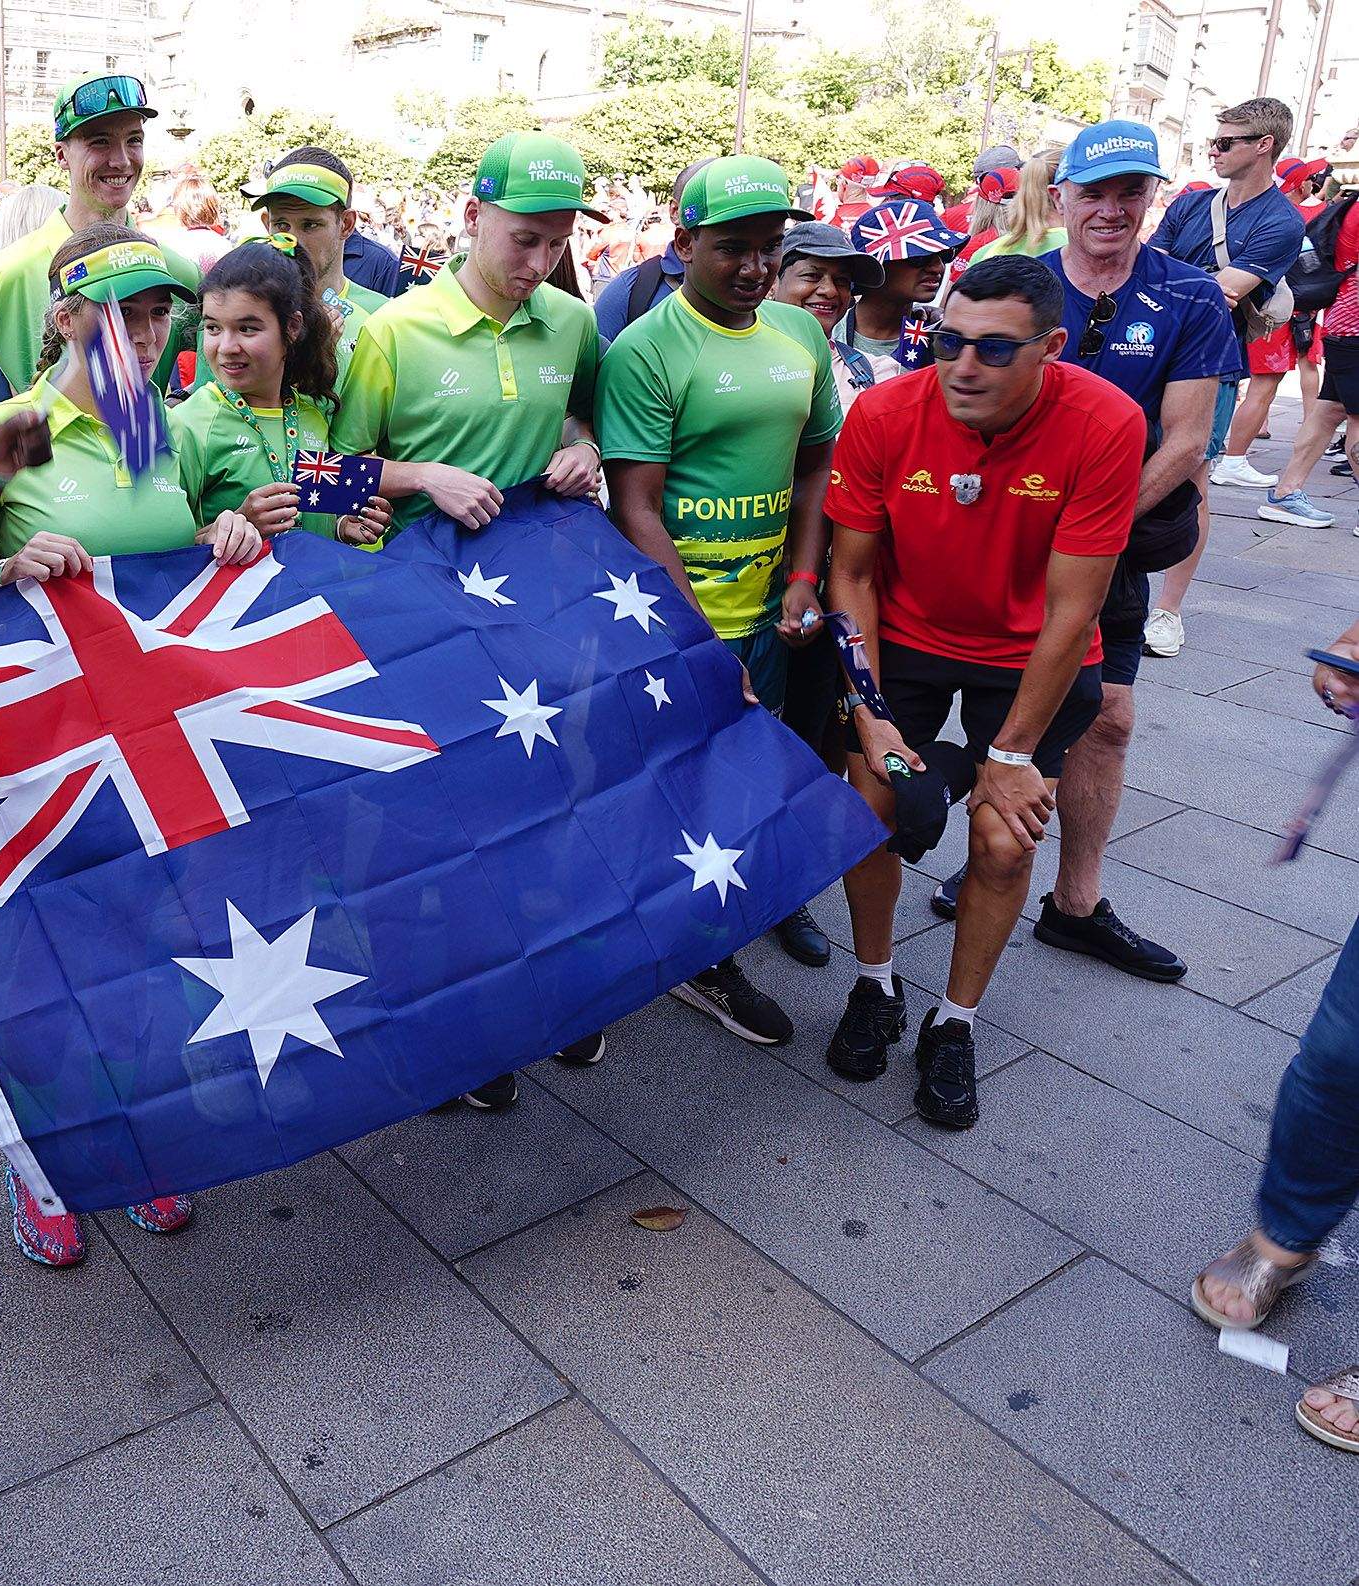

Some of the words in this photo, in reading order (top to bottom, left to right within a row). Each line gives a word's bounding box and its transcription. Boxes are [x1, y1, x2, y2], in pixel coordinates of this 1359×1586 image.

[1085, 136, 1154, 158] Multisport
[528, 159, 554, 171] AUS
[725, 175, 749, 188] AUS
[108, 247, 133, 259] AUS
[538, 366, 557, 375] AUS
[769, 365, 787, 375] AUS
[434, 386, 471, 398] SCODY
[714, 385, 742, 394] SCODY
